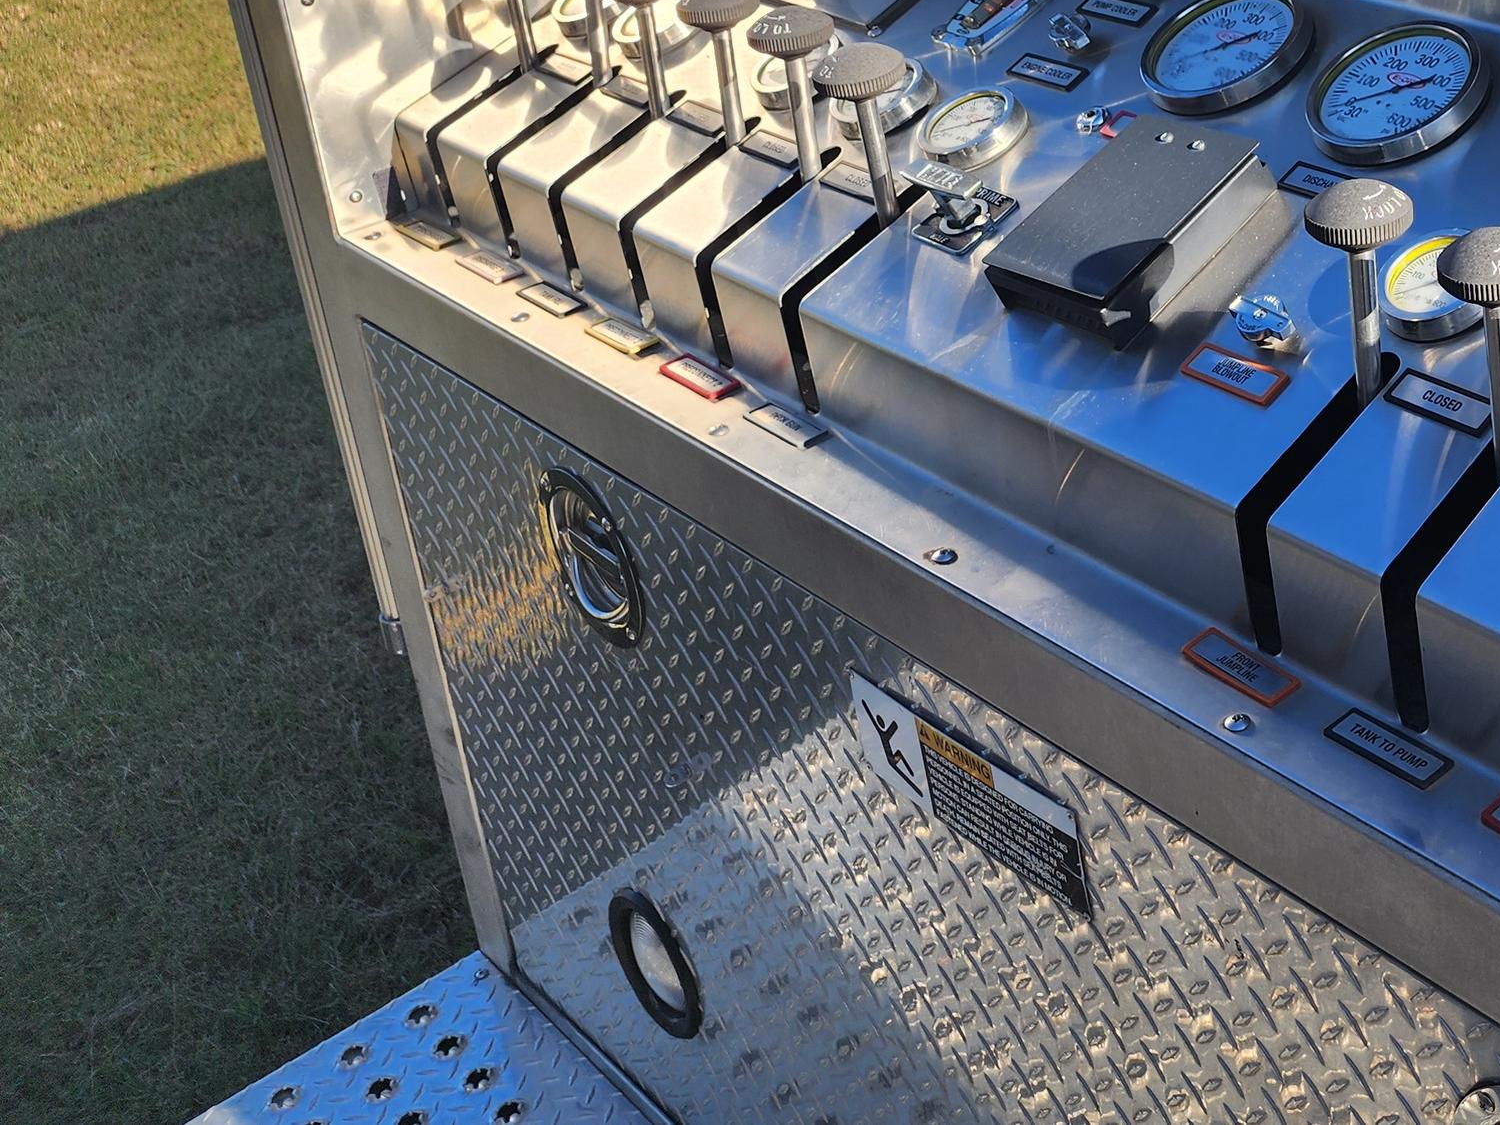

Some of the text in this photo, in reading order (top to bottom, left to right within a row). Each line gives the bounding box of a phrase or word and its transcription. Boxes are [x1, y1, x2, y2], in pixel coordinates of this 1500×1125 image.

[1383, 57, 1408, 71] 200
[1415, 54, 1440, 68] 300
[1357, 74, 1380, 88] 100
[1410, 96, 1435, 110] 500
[1387, 113, 1411, 127] 600
[1211, 362, 1249, 385] BLOWOUT
[1422, 389, 1463, 412] CLOSED
[1215, 655, 1259, 683] JUMPLINE
[1231, 651, 1261, 672] FRONT
[932, 732, 991, 779] WARNING
[1350, 723, 1428, 770] TANK TO PUMP
[937, 754, 964, 777] VEHICLE
[1003, 796, 1018, 812] FOR
[1018, 805, 1054, 835] CARRYING
[960, 787, 992, 815] EQUIPPED
[992, 808, 1009, 826] WITH
[1008, 819, 1026, 837] SEAT
[1026, 830, 1048, 852] BELTS
[1048, 844, 1064, 862] FOR
[960, 796, 992, 824] STANDING
[992, 817, 1014, 839] WHILE
[1013, 831, 1041, 857] VEHICLE
[975, 788, 1001, 811] SEATED
[1000, 804, 1032, 831] POSITION
[1051, 836, 1068, 854] THIS
[1054, 868, 1067, 884] OR
